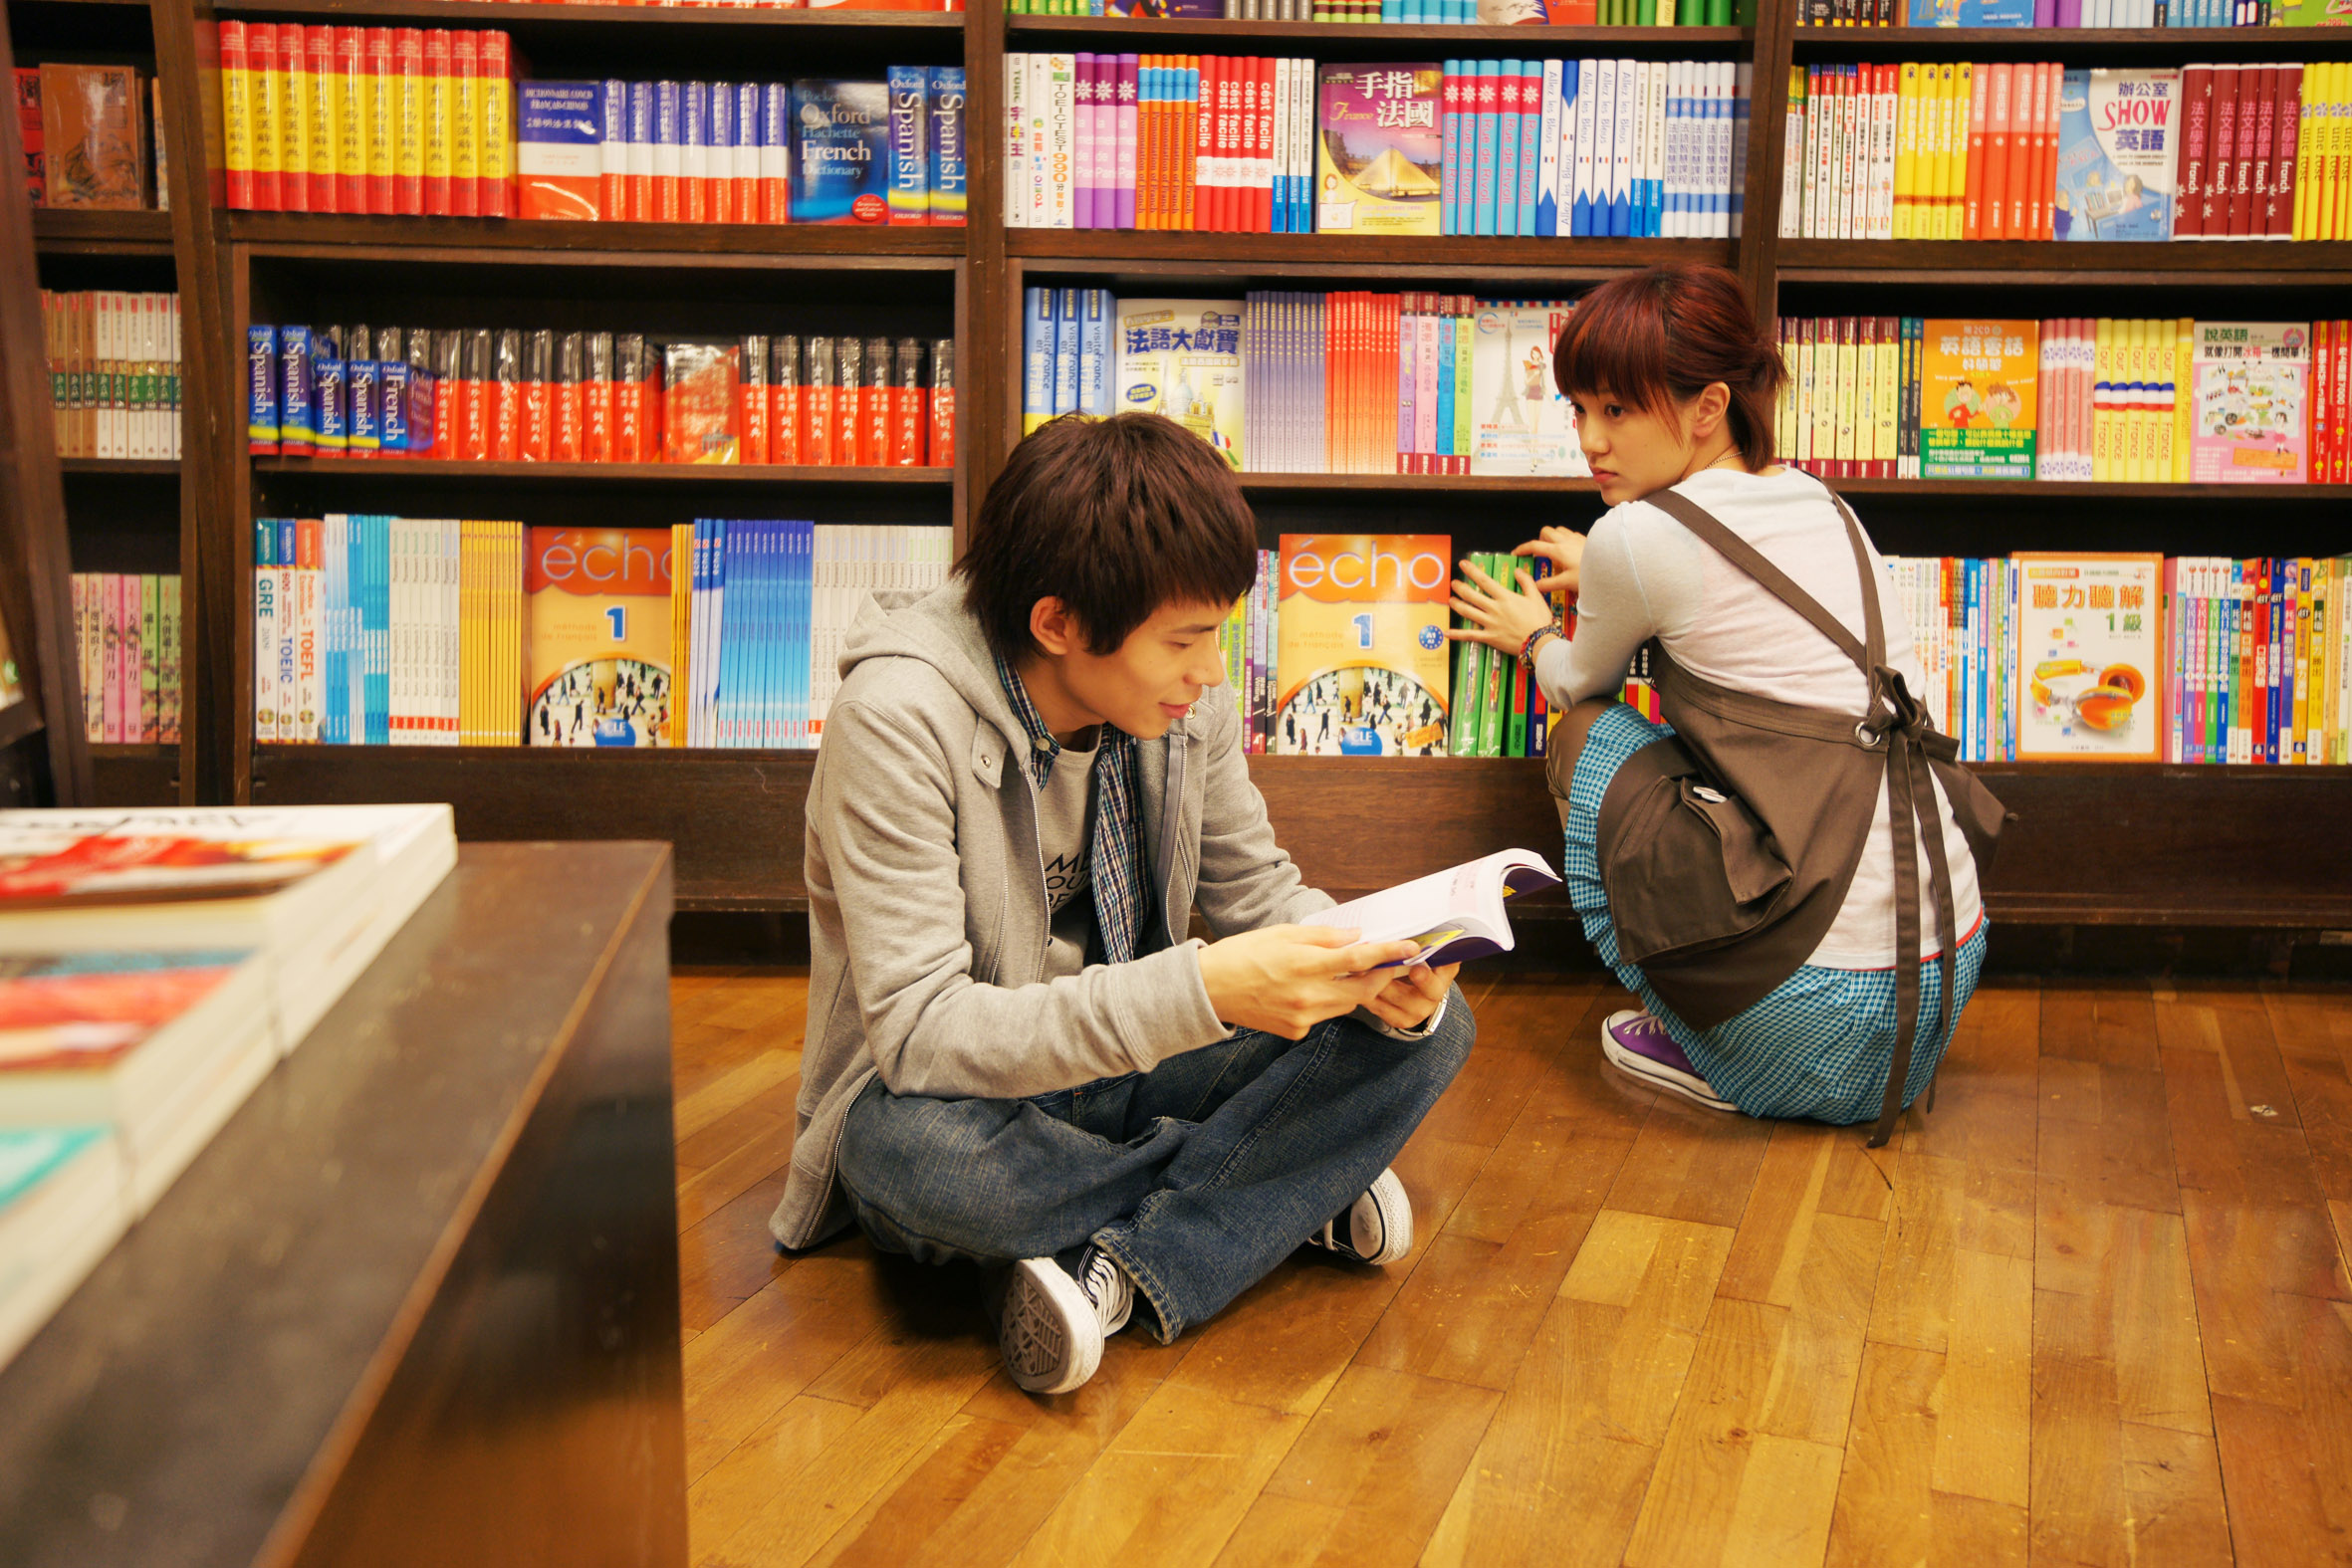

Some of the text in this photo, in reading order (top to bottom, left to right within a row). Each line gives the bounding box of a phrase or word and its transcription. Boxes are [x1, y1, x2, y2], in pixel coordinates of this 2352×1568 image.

[1354, 71, 1414, 100] 手指
[2118, 82, 2169, 98] 辦公室
[801, 103, 871, 125] Oxford
[1199, 112, 1211, 147] facile
[1229, 113, 1241, 148] facile
[1244, 113, 1256, 148] facile
[1259, 114, 1272, 150] facile
[1376, 101, 1435, 128] 法國
[2097, 100, 2172, 131] SHOW
[802, 139, 871, 161] French
[891, 93, 923, 189] Spanish
[933, 94, 965, 190] Spanish
[2115, 129, 2165, 151] 英語
[2188, 101, 2206, 194] 法文學習 franch
[2217, 101, 2234, 194] 法文學習 franch
[2237, 101, 2256, 194] 法文學習 franch
[2255, 101, 2273, 194] 法文學習 franch
[2301, 127, 2310, 151] une
[2316, 126, 2325, 150] une
[2331, 126, 2340, 150] une
[803, 163, 863, 178] Dictionary
[1446, 118, 1458, 204] Rue de Rivoli
[1462, 118, 1475, 204] Rue de Rivoli
[1480, 118, 1494, 204] Rue de Rivoli
[1036, 339, 1044, 352] en
[1085, 340, 1093, 353] en
[1126, 328, 1240, 354] 法語大獻寶
[1940, 336, 2024, 356] 英語會話
[2204, 328, 2248, 342] 說英語
[250, 341, 274, 414] Spanish
[283, 341, 307, 414] Spanish
[1043, 352, 1054, 390] France
[1093, 352, 1104, 390] France
[319, 371, 341, 435] Spanish
[351, 372, 373, 436] Spanish
[385, 373, 405, 441] French
[2098, 344, 2111, 459] Tour France
[2114, 345, 2127, 460] Tour France
[2130, 344, 2143, 459] Tour France
[2146, 345, 2159, 460] Tour France
[542, 532, 672, 581] éch
[1289, 538, 1445, 588] écho
[258, 578, 274, 618] GRE
[2032, 584, 2144, 609] 聽力聽解
[604, 604, 626, 641] 1
[1353, 613, 1373, 649] 1
[2106, 612, 2142, 632] 1 級
[280, 637, 293, 684] TOEIC
[300, 630, 314, 681] TOEFL
[604, 722, 625, 732] CLE
[1350, 732, 1372, 742] CLE
